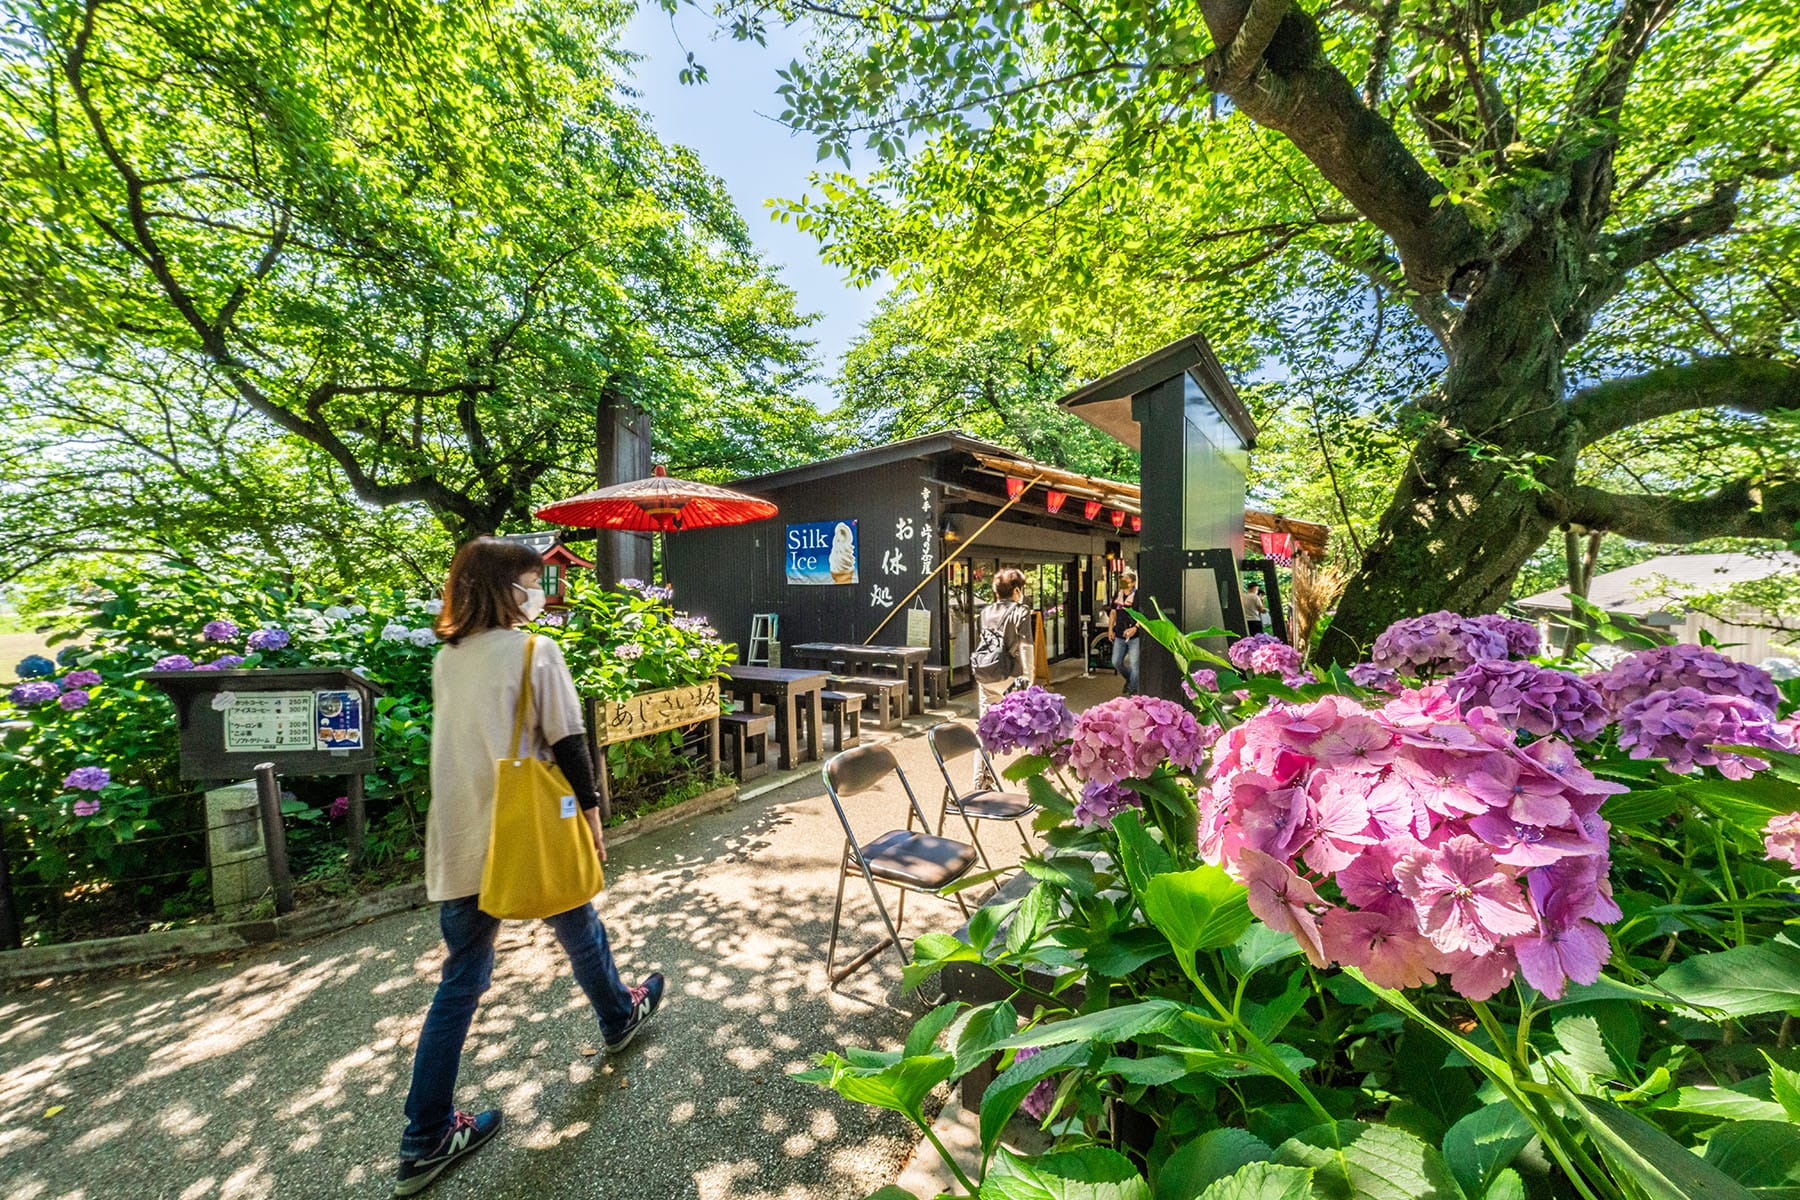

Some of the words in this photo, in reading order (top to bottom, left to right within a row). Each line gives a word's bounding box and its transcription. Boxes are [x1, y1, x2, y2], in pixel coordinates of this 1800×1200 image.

[788, 528, 829, 550] Silk
[790, 551, 817, 570] Ice
[870, 517, 914, 608] お休処
[611, 684, 719, 727] あじさい坂
[447, 1127, 471, 1155] N
